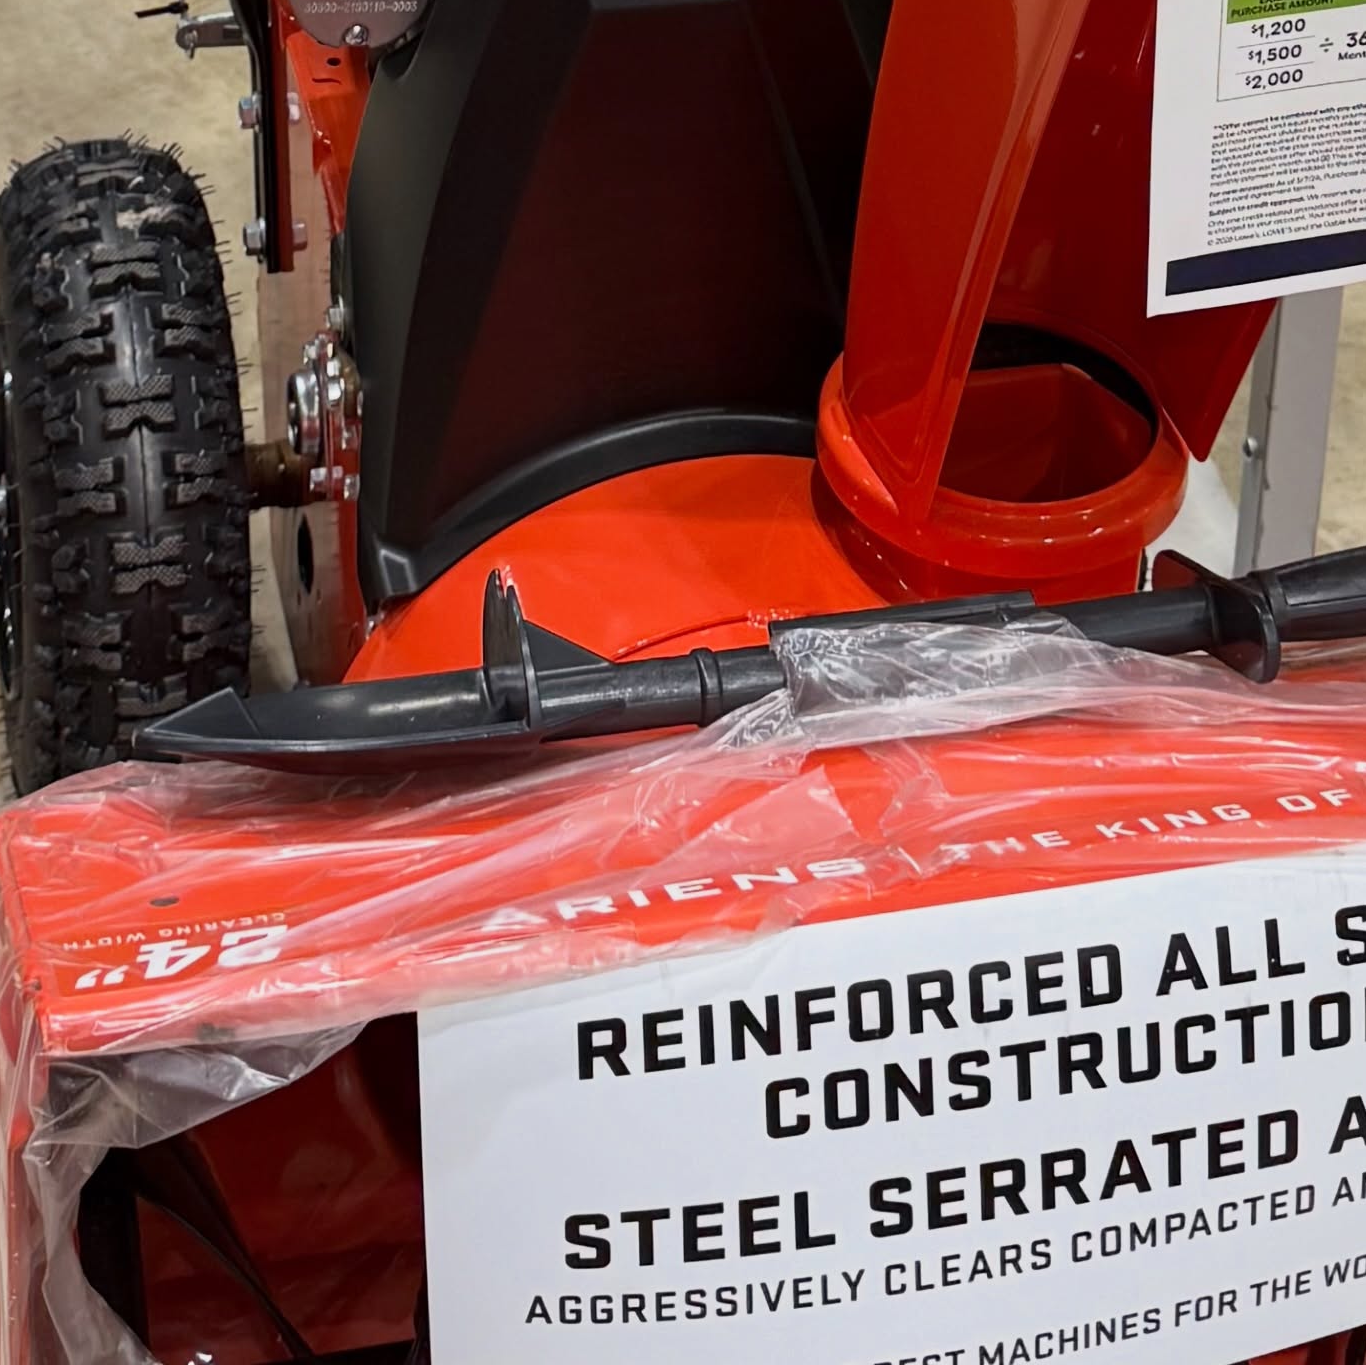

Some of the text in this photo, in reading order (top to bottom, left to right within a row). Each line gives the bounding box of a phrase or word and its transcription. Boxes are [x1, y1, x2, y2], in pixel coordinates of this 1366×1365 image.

[1231, 1, 1286, 18] PURCHASE
[1251, 18, 1306, 40] $1,200
[1245, 69, 1303, 91] $2,000
[1248, 44, 1303, 65] $1,500
[481, 788, 1355, 933] ARIENS THE KING OF
[62, 912, 286, 952] CLEARING WIDTH
[577, 942, 1123, 1081] REINFORCED
[1156, 917, 1305, 997] ALL
[564, 1190, 836, 1270] STEEL
[869, 1109, 1299, 1239] SERRATED
[525, 1269, 866, 1326] AGGRESSIVELY
[884, 1237, 1053, 1296] CLEARS
[1071, 1183, 1315, 1264] COMPACTED
[978, 1306, 1161, 1365] MACHINES
[1174, 1288, 1237, 1328] FOR
[1250, 1269, 1313, 1308] THE
